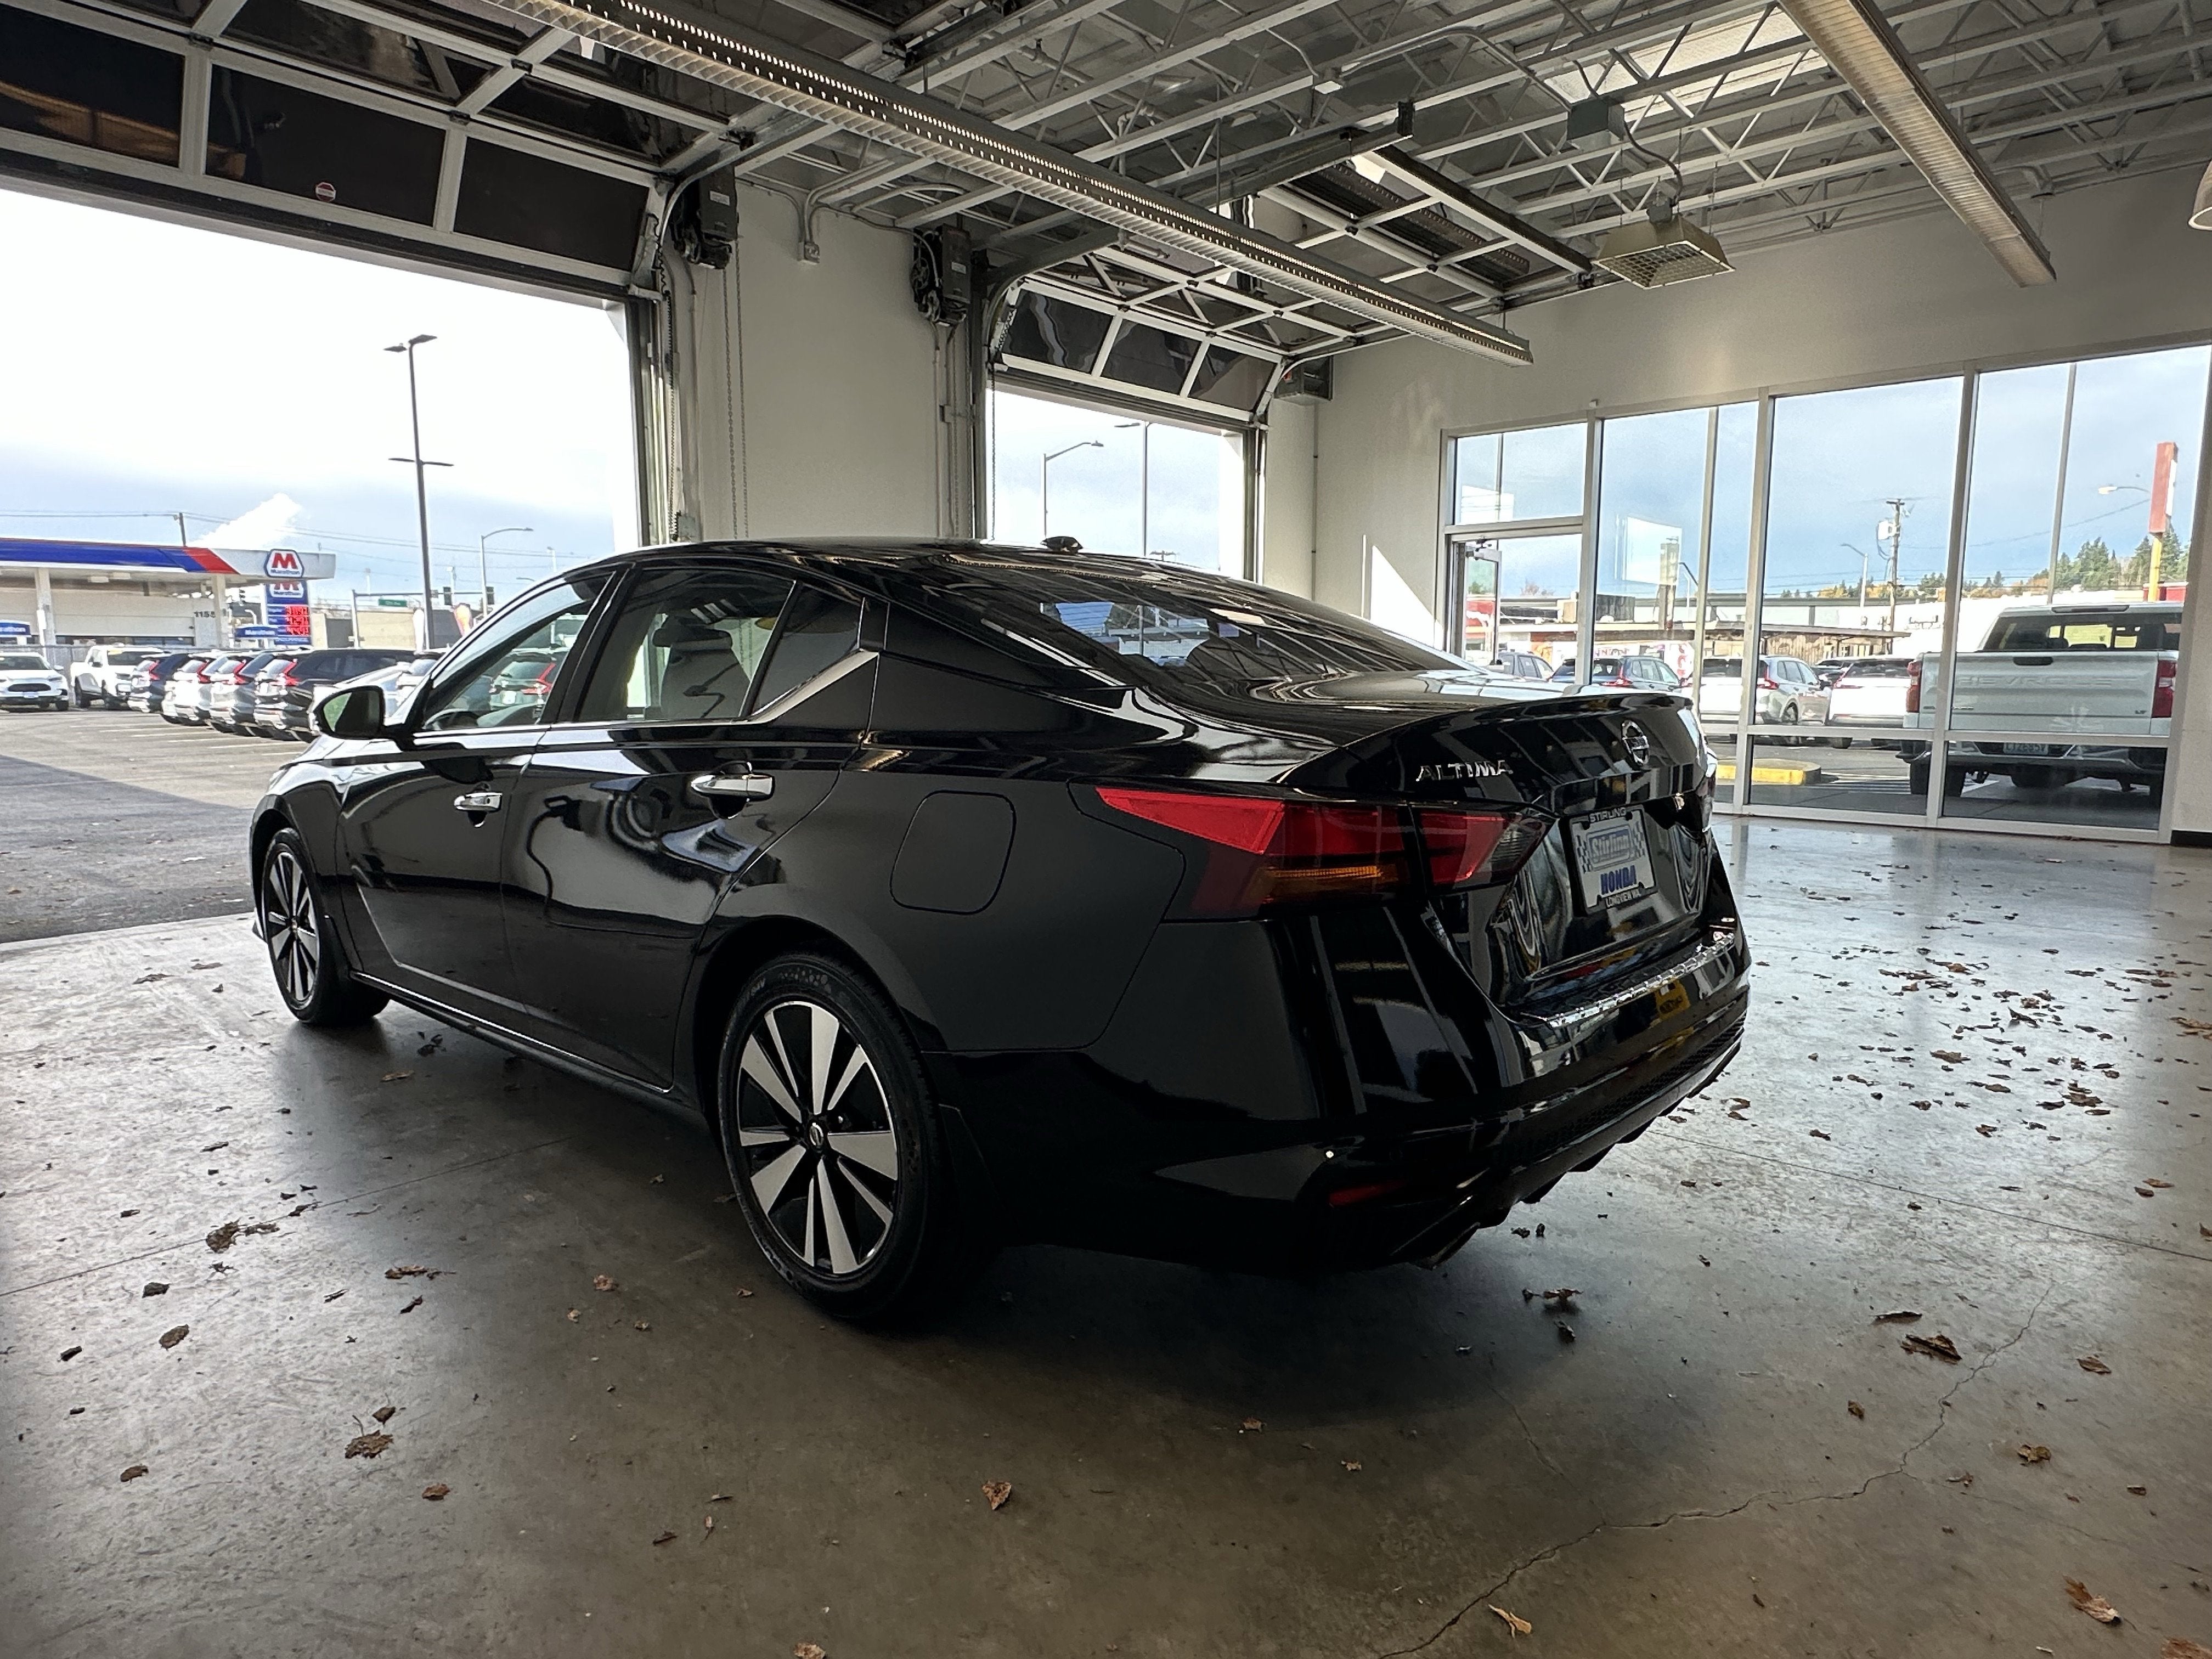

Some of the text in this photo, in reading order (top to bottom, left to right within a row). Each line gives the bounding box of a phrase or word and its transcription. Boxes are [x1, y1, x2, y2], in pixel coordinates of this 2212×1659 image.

[271, 552, 298, 569] M
[1953, 675, 2138, 686] HEVROLET
[1415, 759, 1514, 782] ALTIMA
[1589, 807, 1626, 823] STIRLING
[1600, 865, 1637, 895] HONDA
